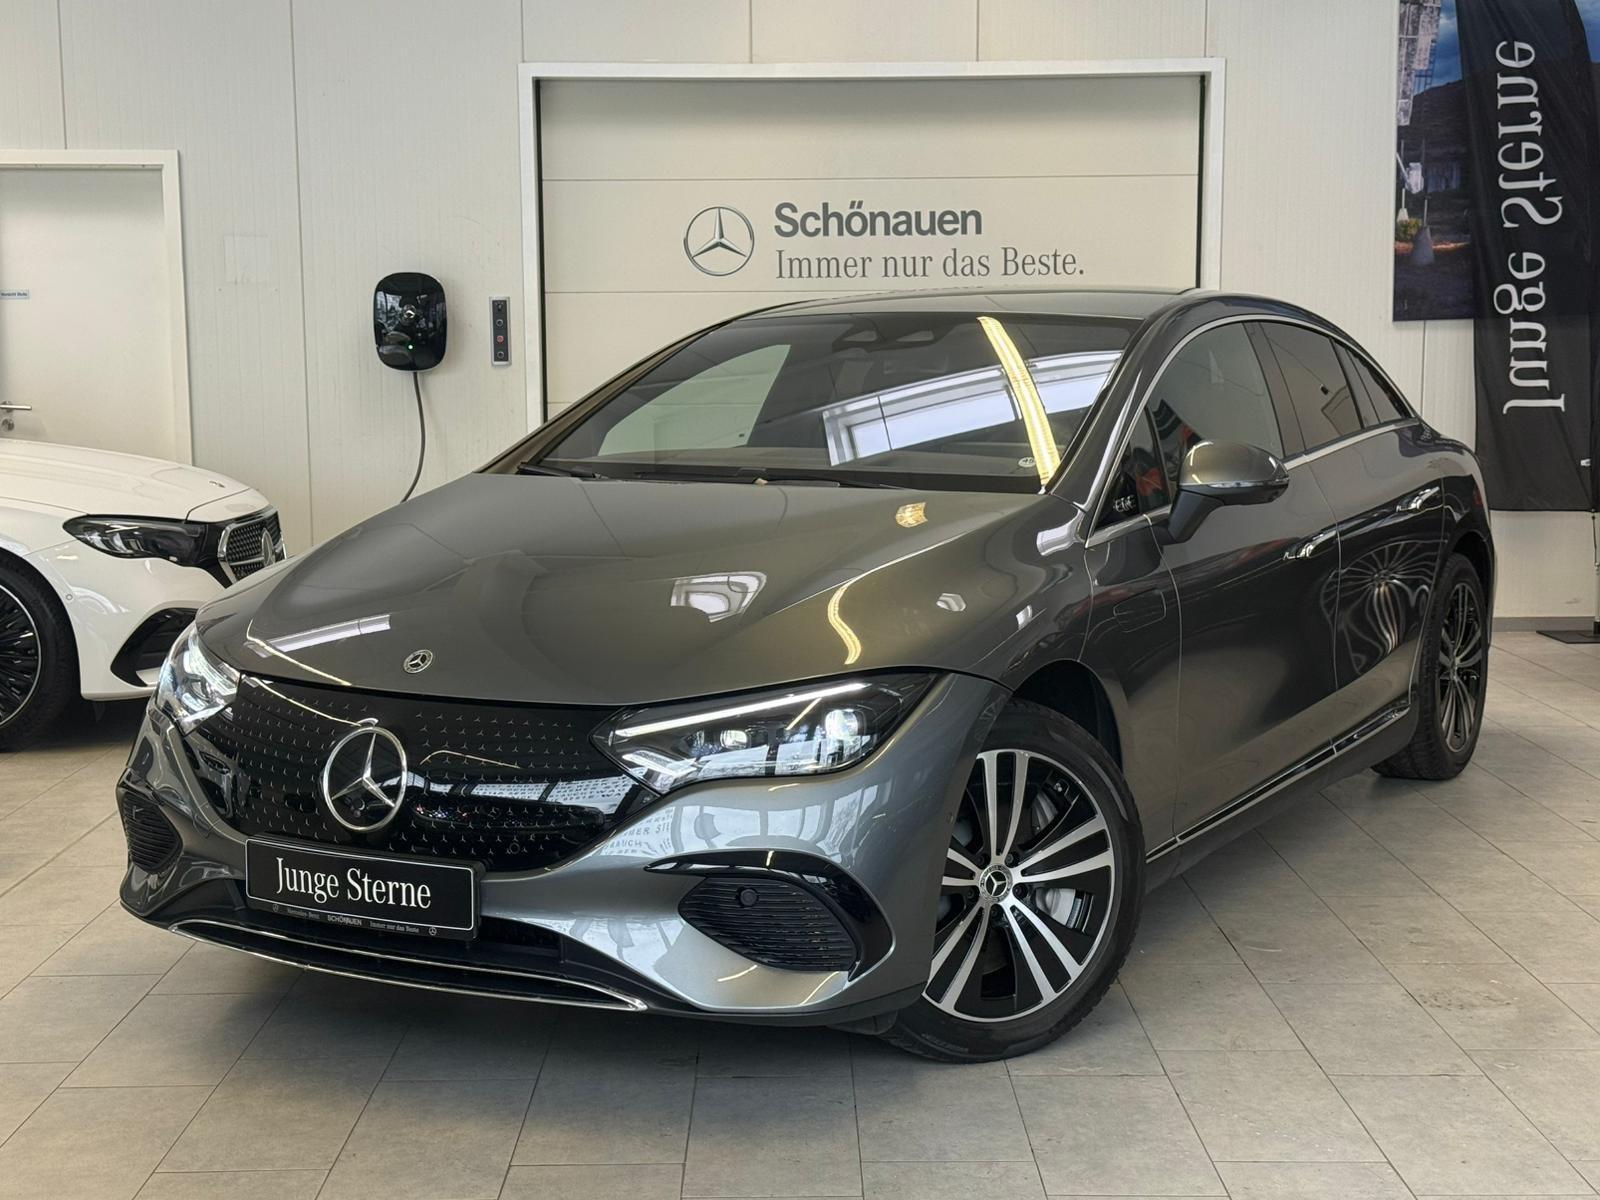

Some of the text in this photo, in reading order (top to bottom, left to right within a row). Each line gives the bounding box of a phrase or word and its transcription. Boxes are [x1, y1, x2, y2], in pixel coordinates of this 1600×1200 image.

[773, 200, 983, 239] Schönauen
[775, 246, 1085, 280] Immer nur das Beste.
[275, 857, 432, 909] Junge Sterne
